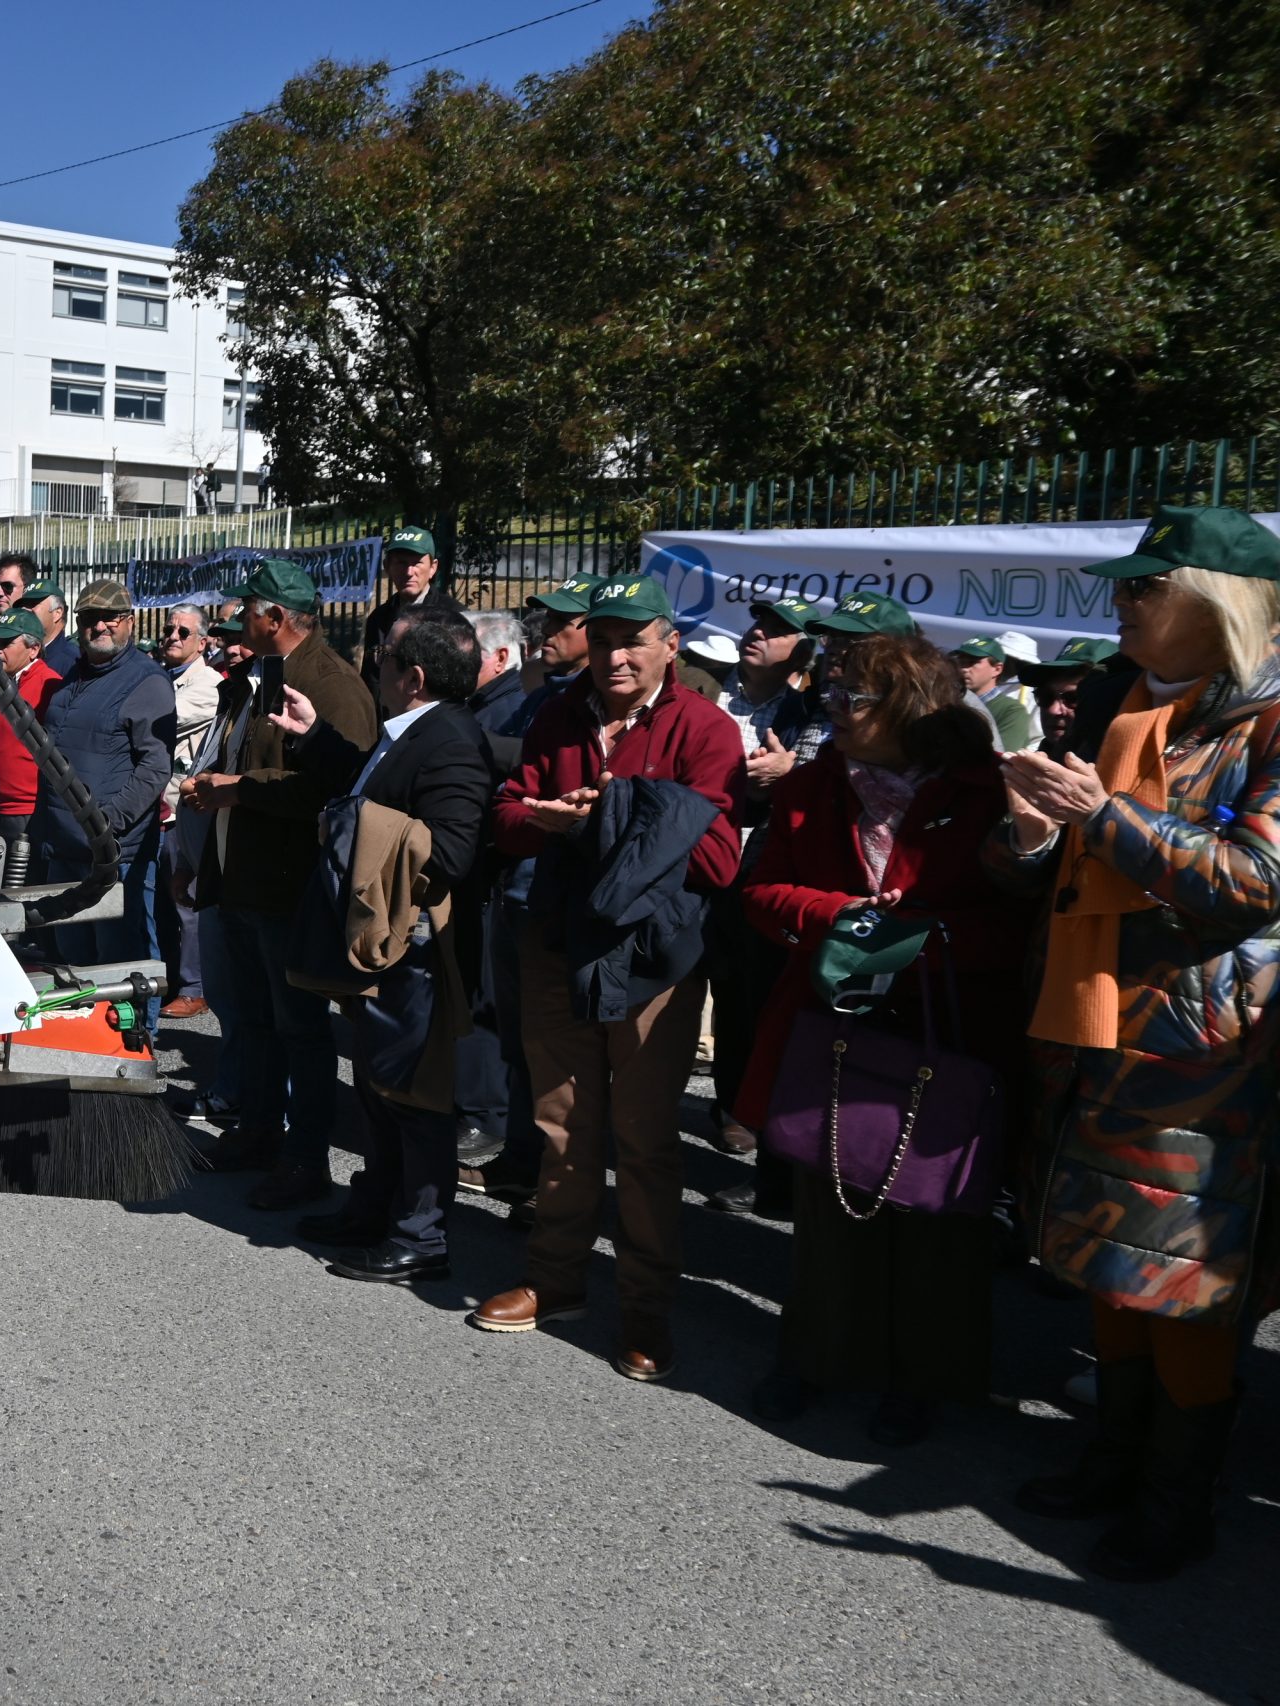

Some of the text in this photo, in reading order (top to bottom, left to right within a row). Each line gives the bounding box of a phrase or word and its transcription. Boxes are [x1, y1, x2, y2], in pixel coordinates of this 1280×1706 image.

[394, 532, 415, 541] CAP
[595, 585, 625, 603] CAP
[851, 910, 881, 938] CAP
